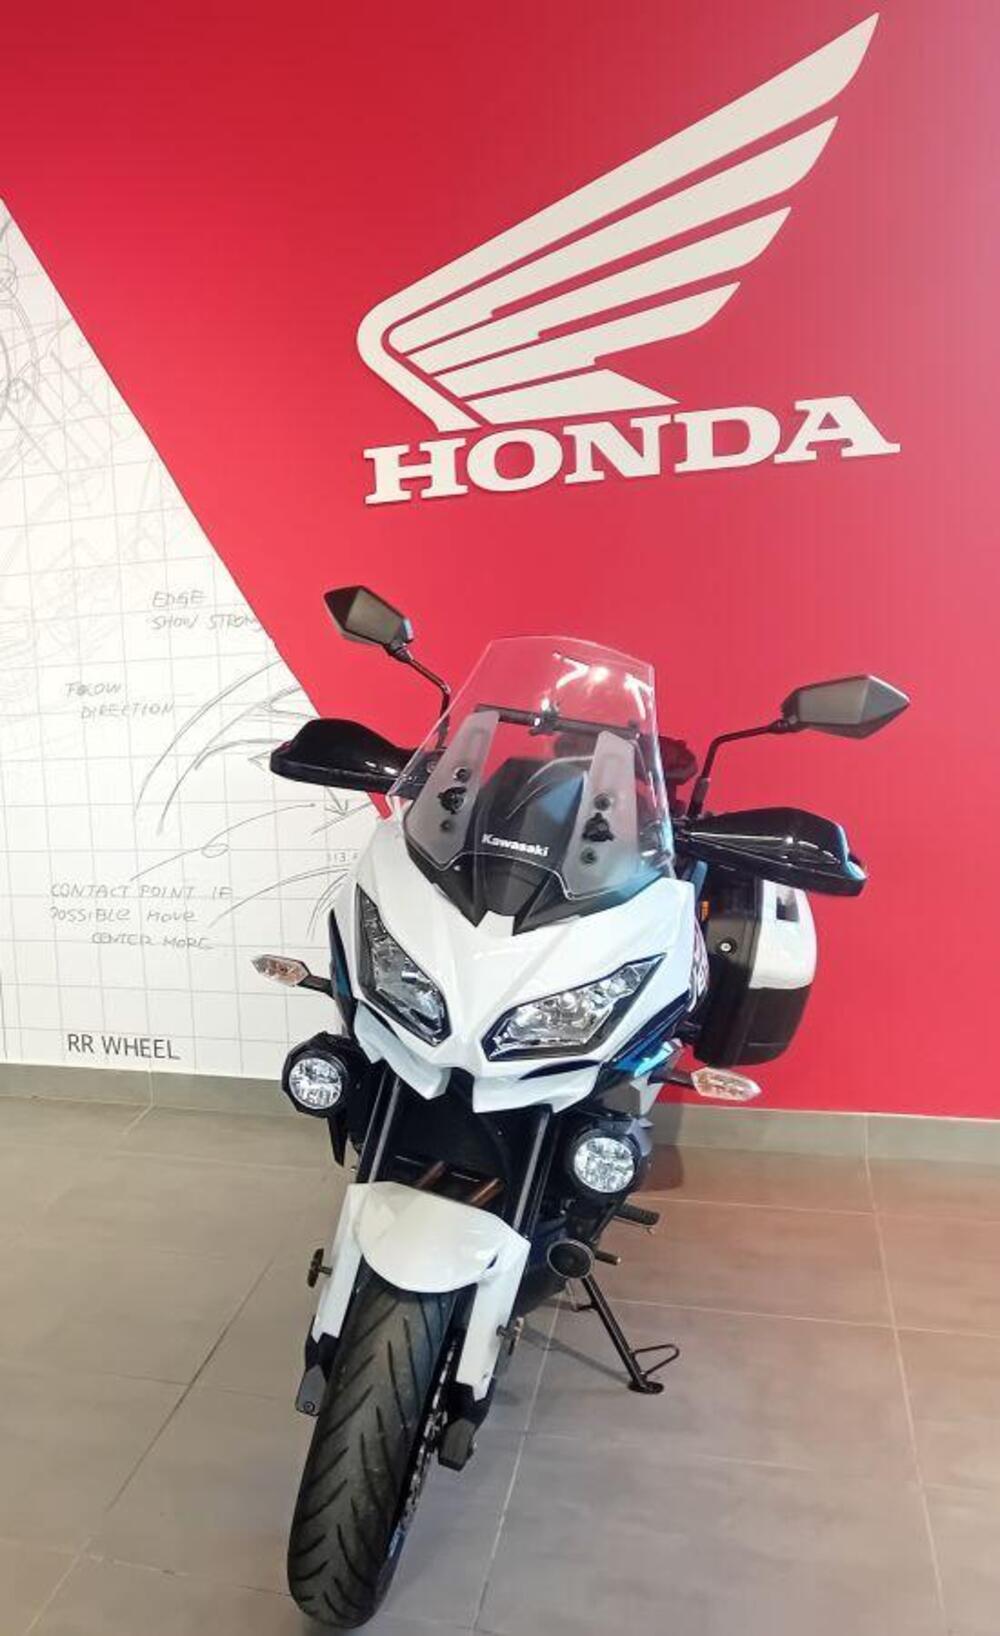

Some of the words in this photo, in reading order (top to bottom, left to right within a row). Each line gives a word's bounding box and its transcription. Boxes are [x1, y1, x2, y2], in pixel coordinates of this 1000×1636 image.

[363, 396, 901, 504] HONDA
[152, 590, 206, 608] EDGE
[151, 615, 199, 630] SHOW
[81, 702, 174, 722] DIRECTION
[481, 833, 549, 857] Kawasaki
[51, 883, 130, 899] CONTACT
[139, 884, 195, 900] POINT
[212, 886, 233, 899] IF
[163, 934, 214, 950] MORE
[67, 1033, 95, 1054] RR
[101, 1034, 181, 1060] WHEEL
